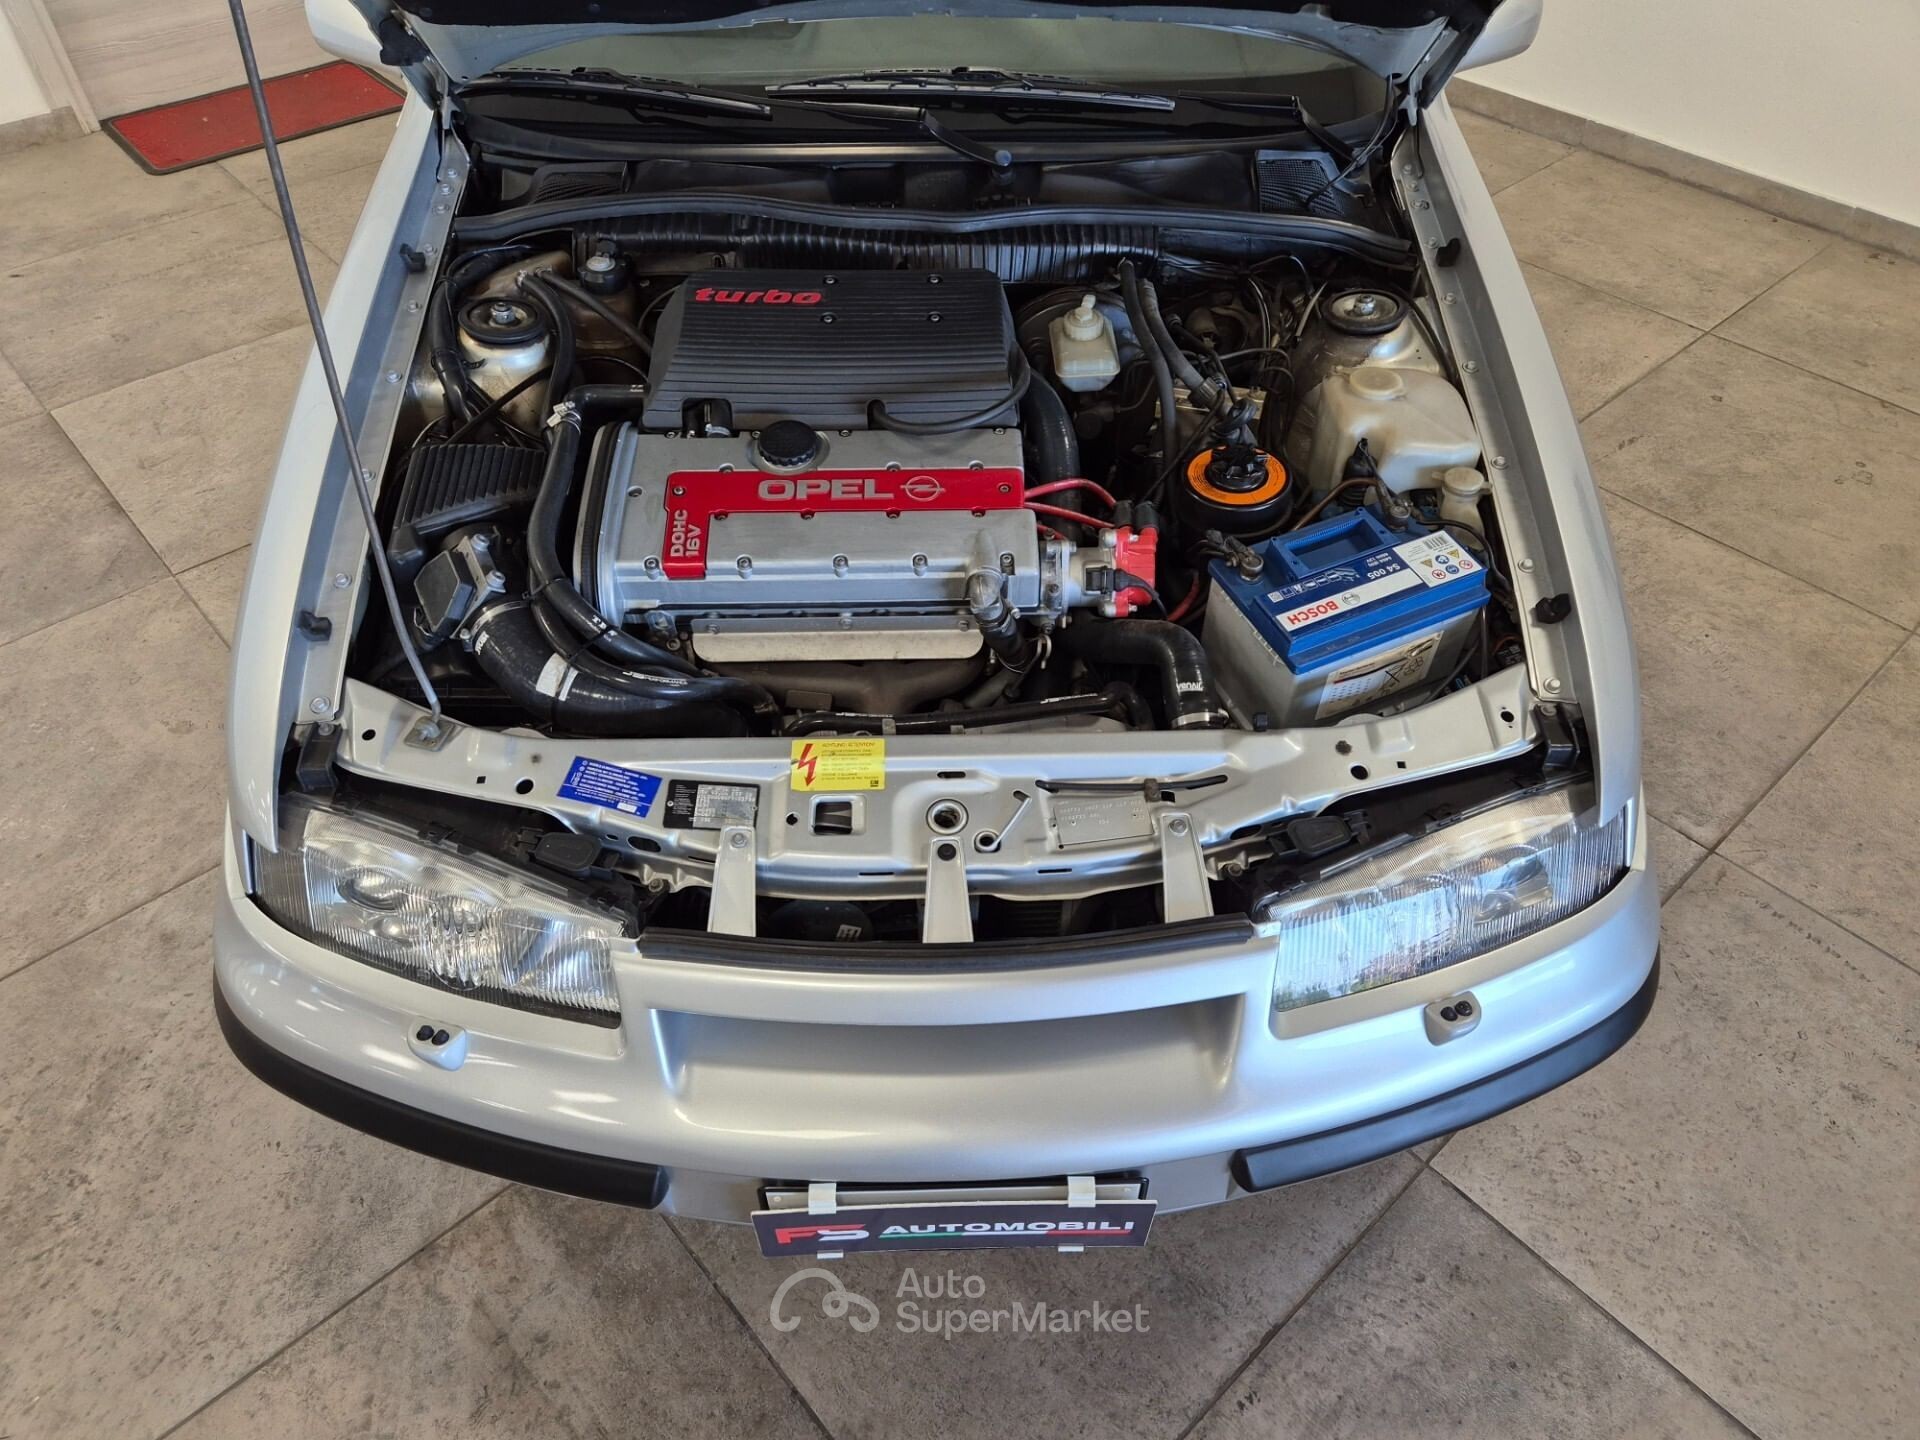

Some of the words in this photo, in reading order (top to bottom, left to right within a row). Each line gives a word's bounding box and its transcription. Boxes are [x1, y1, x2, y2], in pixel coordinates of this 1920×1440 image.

[695, 287, 822, 304] turbo
[757, 478, 895, 501] OPEL
[669, 508, 689, 558] DOHC
[685, 523, 702, 557] 16V
[1367, 568, 1387, 580] 005
[1386, 563, 1401, 575] S4
[1287, 599, 1340, 626] BOSCH
[775, 1223, 870, 1245] FS
[882, 1220, 1135, 1235] AUTOMOBILI
